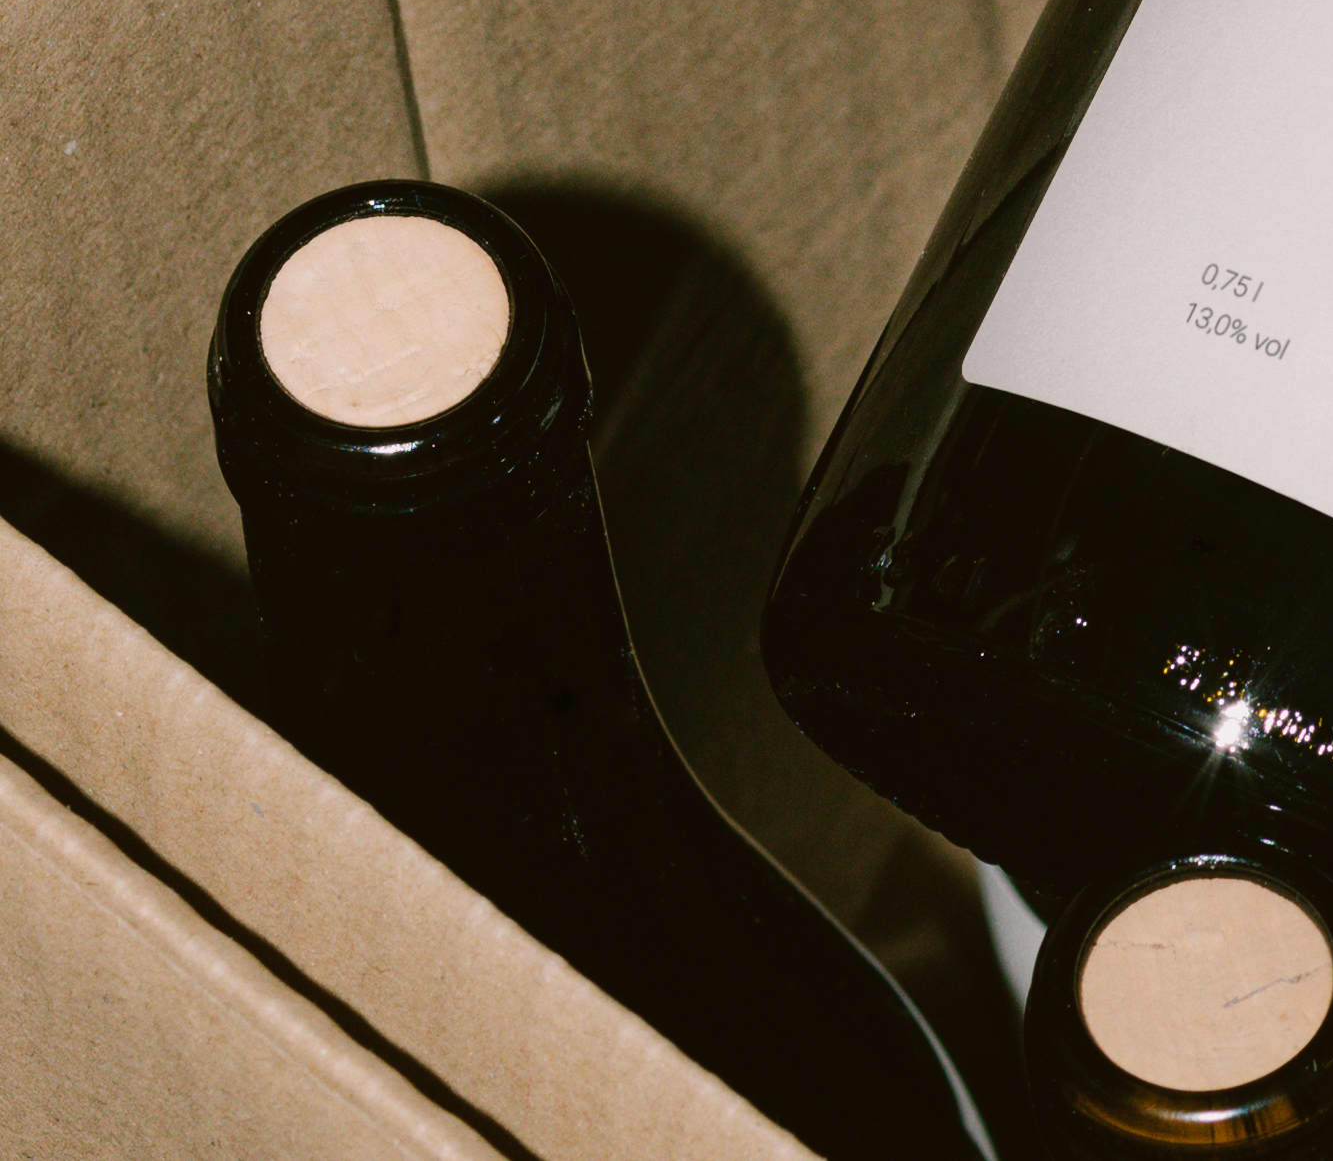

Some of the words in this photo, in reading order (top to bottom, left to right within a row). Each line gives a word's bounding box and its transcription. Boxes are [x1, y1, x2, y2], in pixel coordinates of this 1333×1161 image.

[1201, 263, 1252, 298] 0,75
[1186, 302, 1248, 344] 13,0%
[1255, 332, 1291, 360] vol
